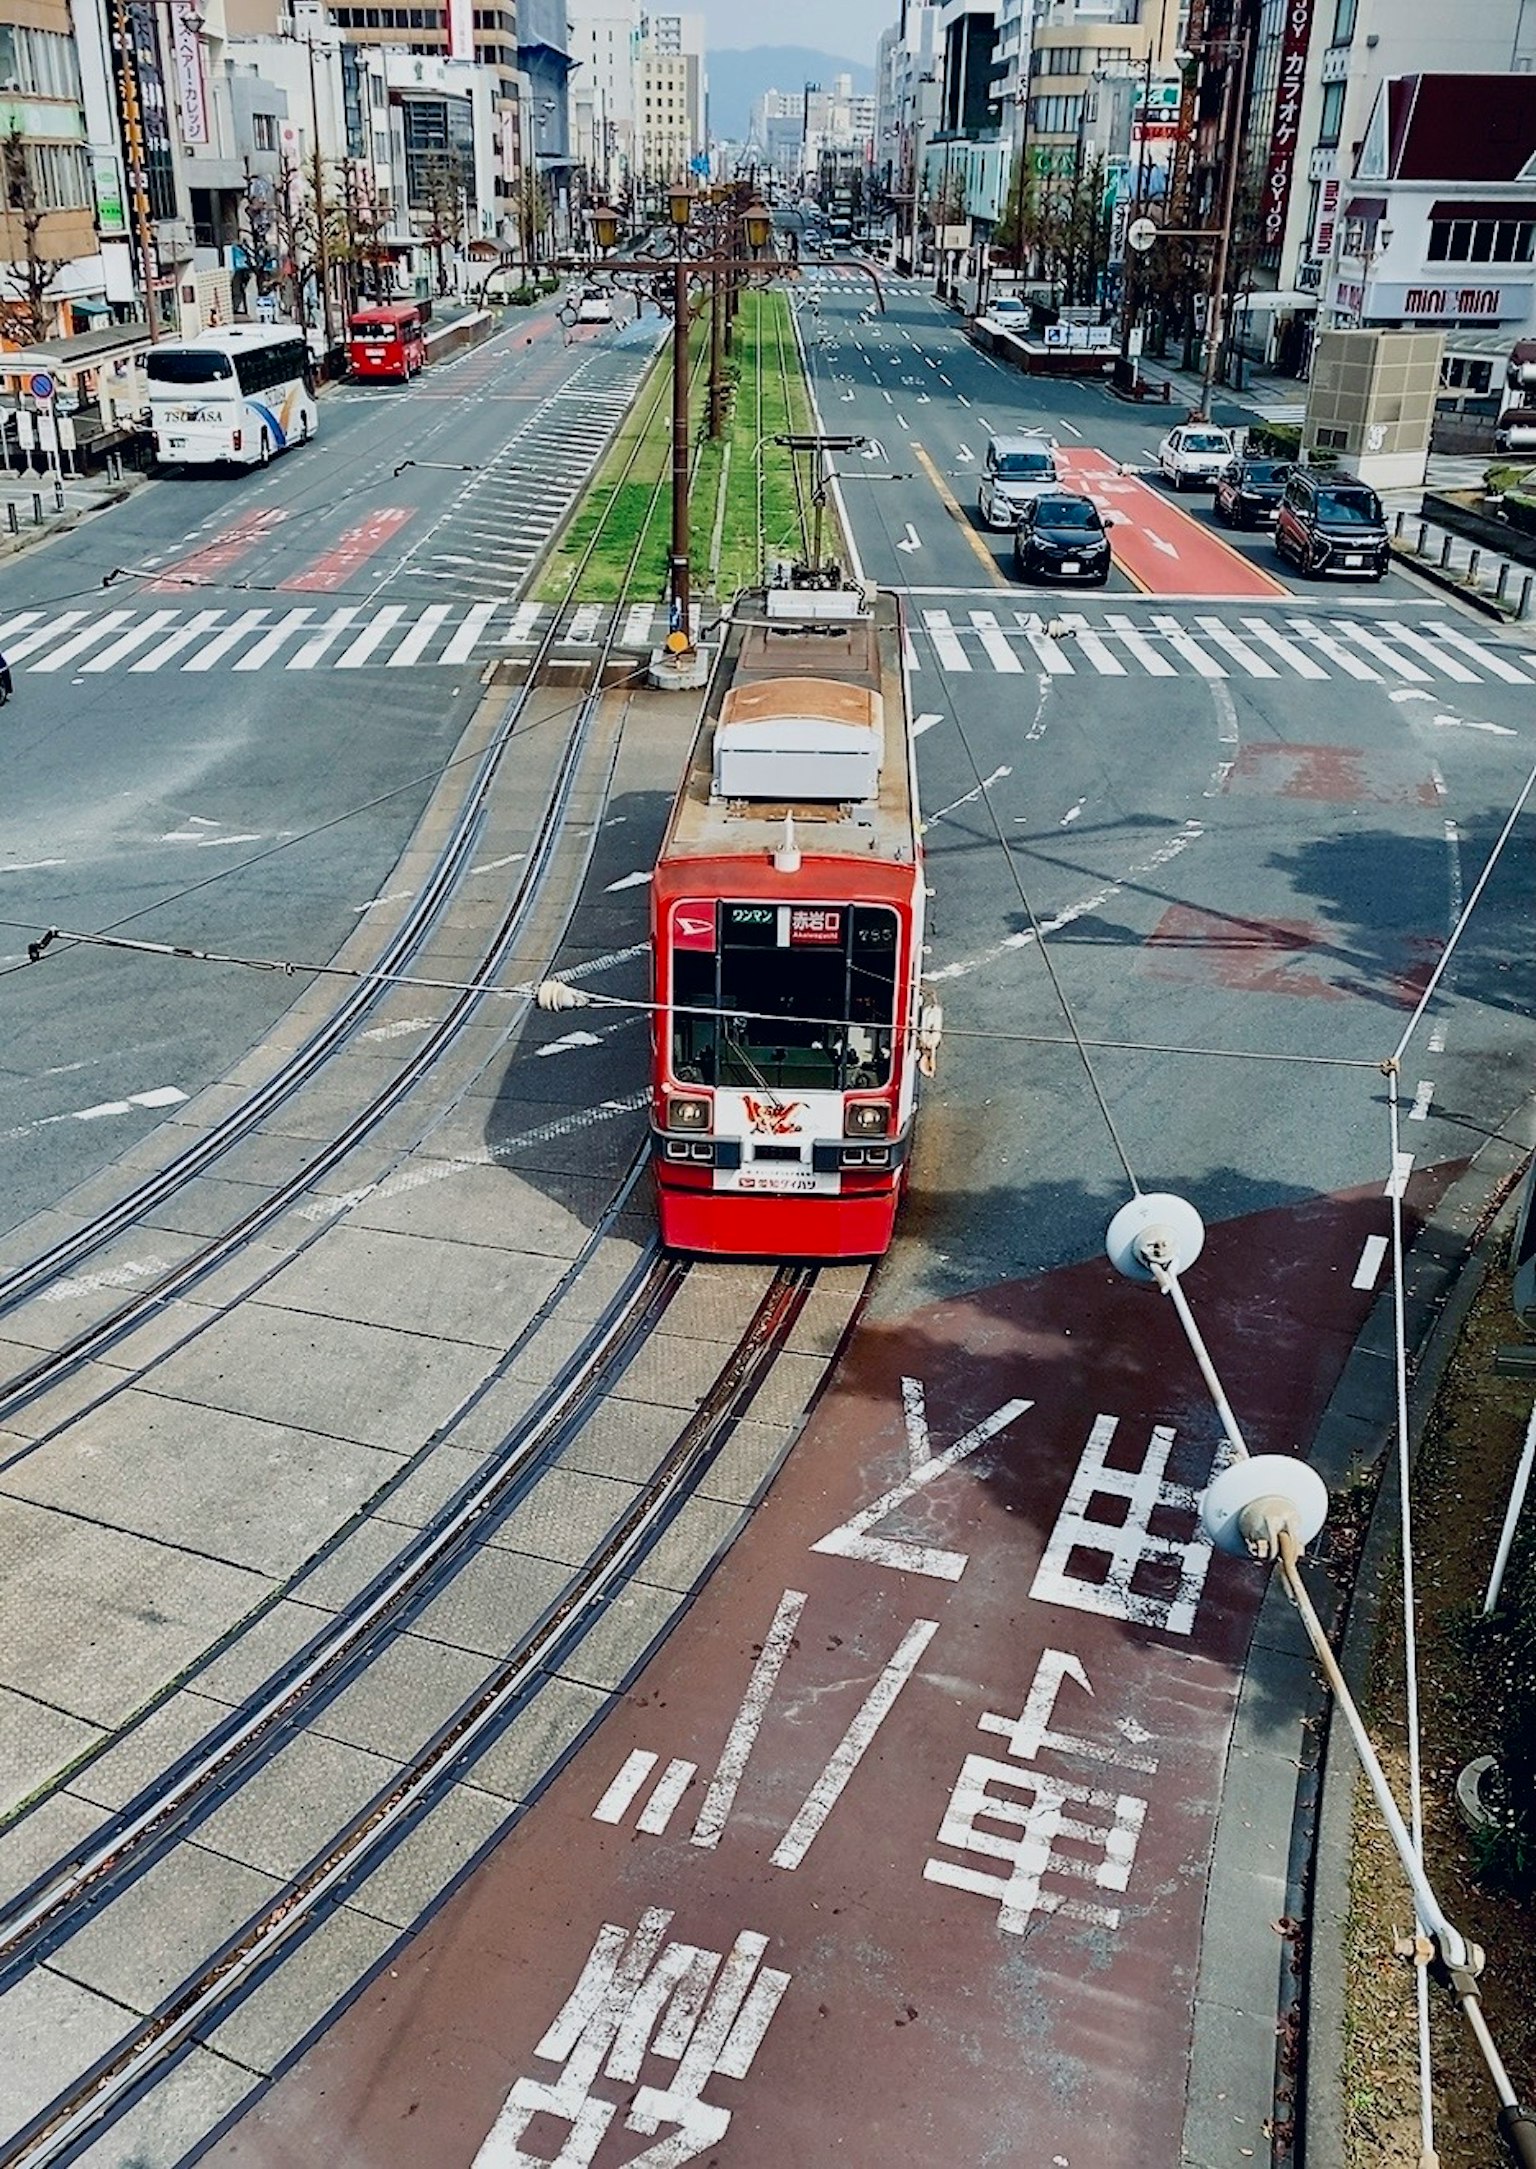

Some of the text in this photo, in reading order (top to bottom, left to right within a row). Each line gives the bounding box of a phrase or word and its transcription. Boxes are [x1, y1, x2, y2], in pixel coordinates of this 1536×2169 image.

[1275, 51, 1305, 146] カラオケ
[1404, 289, 1500, 313] mini mini
[732, 909, 773, 923] ワンマン
[791, 910, 840, 931] 赤岩口
